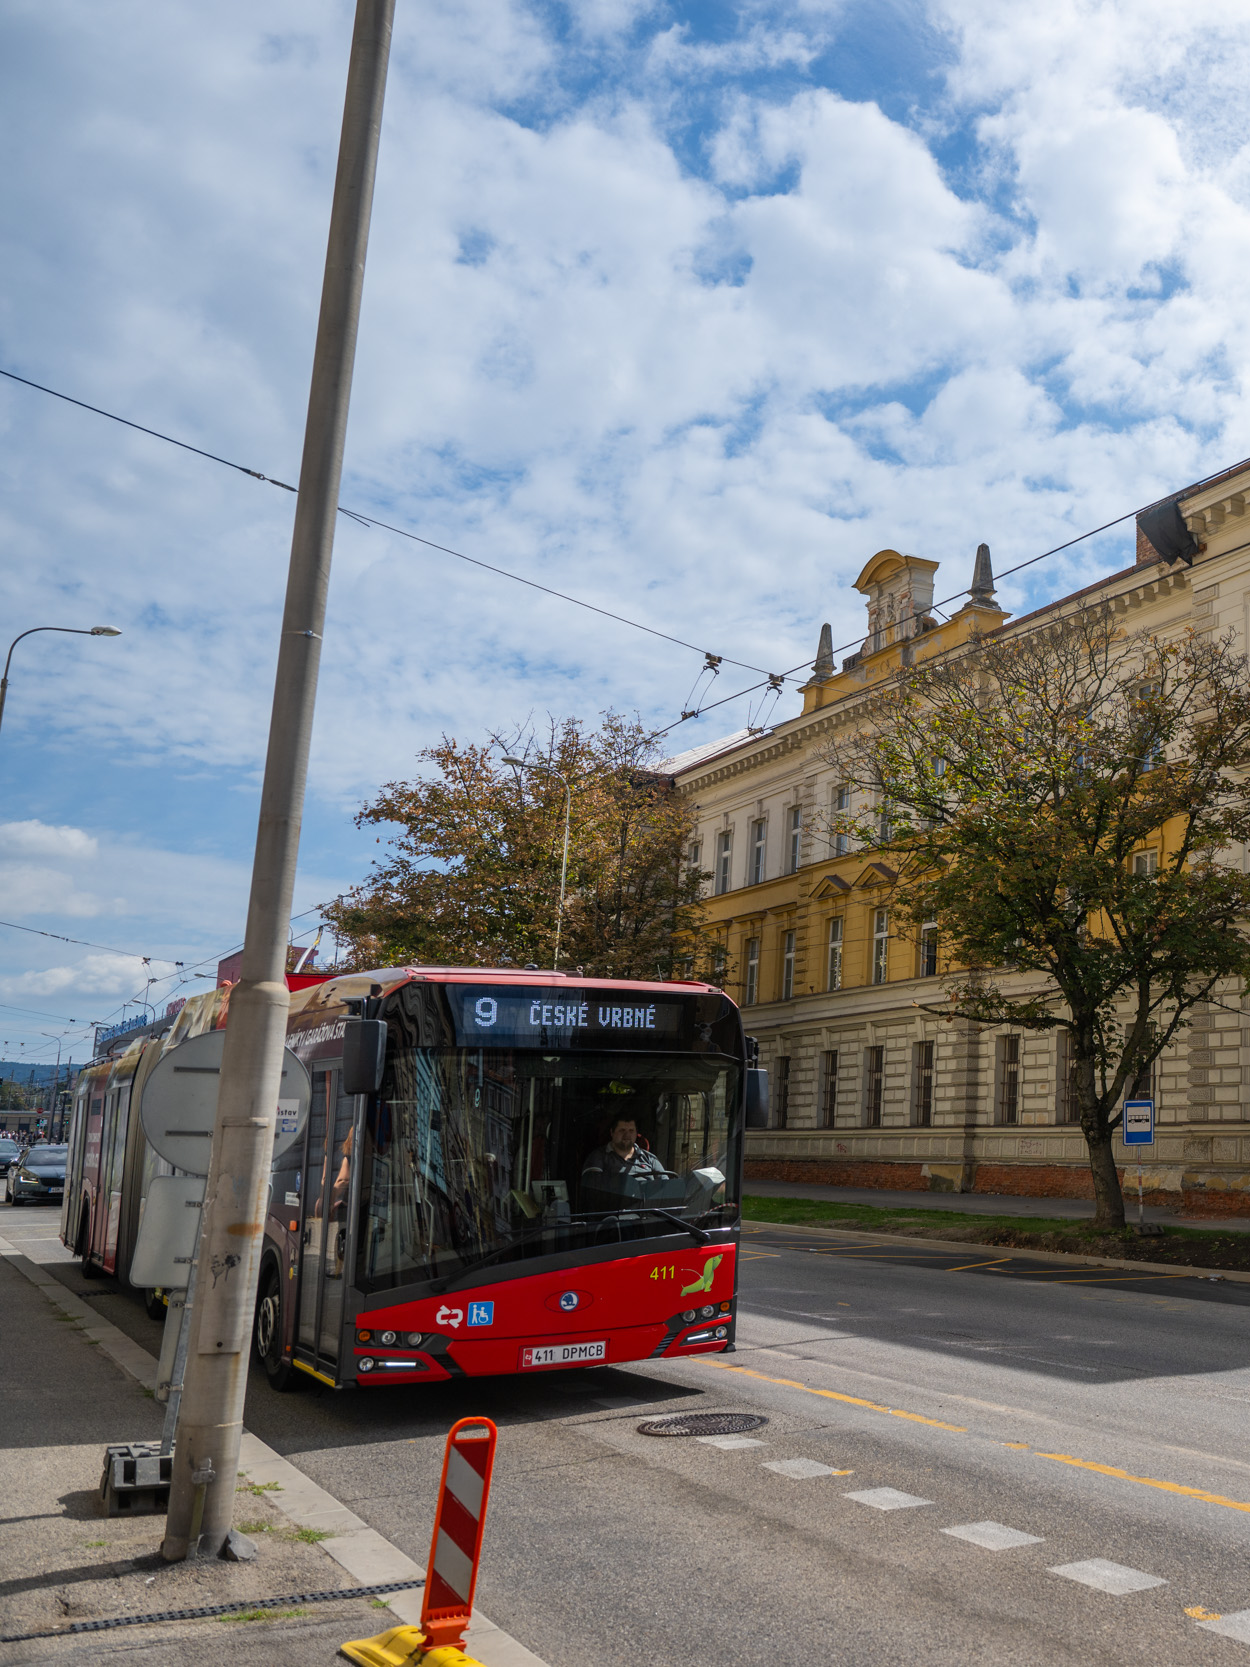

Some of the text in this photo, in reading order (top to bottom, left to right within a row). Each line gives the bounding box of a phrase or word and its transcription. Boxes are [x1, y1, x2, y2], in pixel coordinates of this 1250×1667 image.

[475, 997, 656, 1029] 9 ČESKÉ VRBNÉ
[650, 1265, 676, 1281] 411
[534, 1343, 604, 1362] 411 DPMCB
